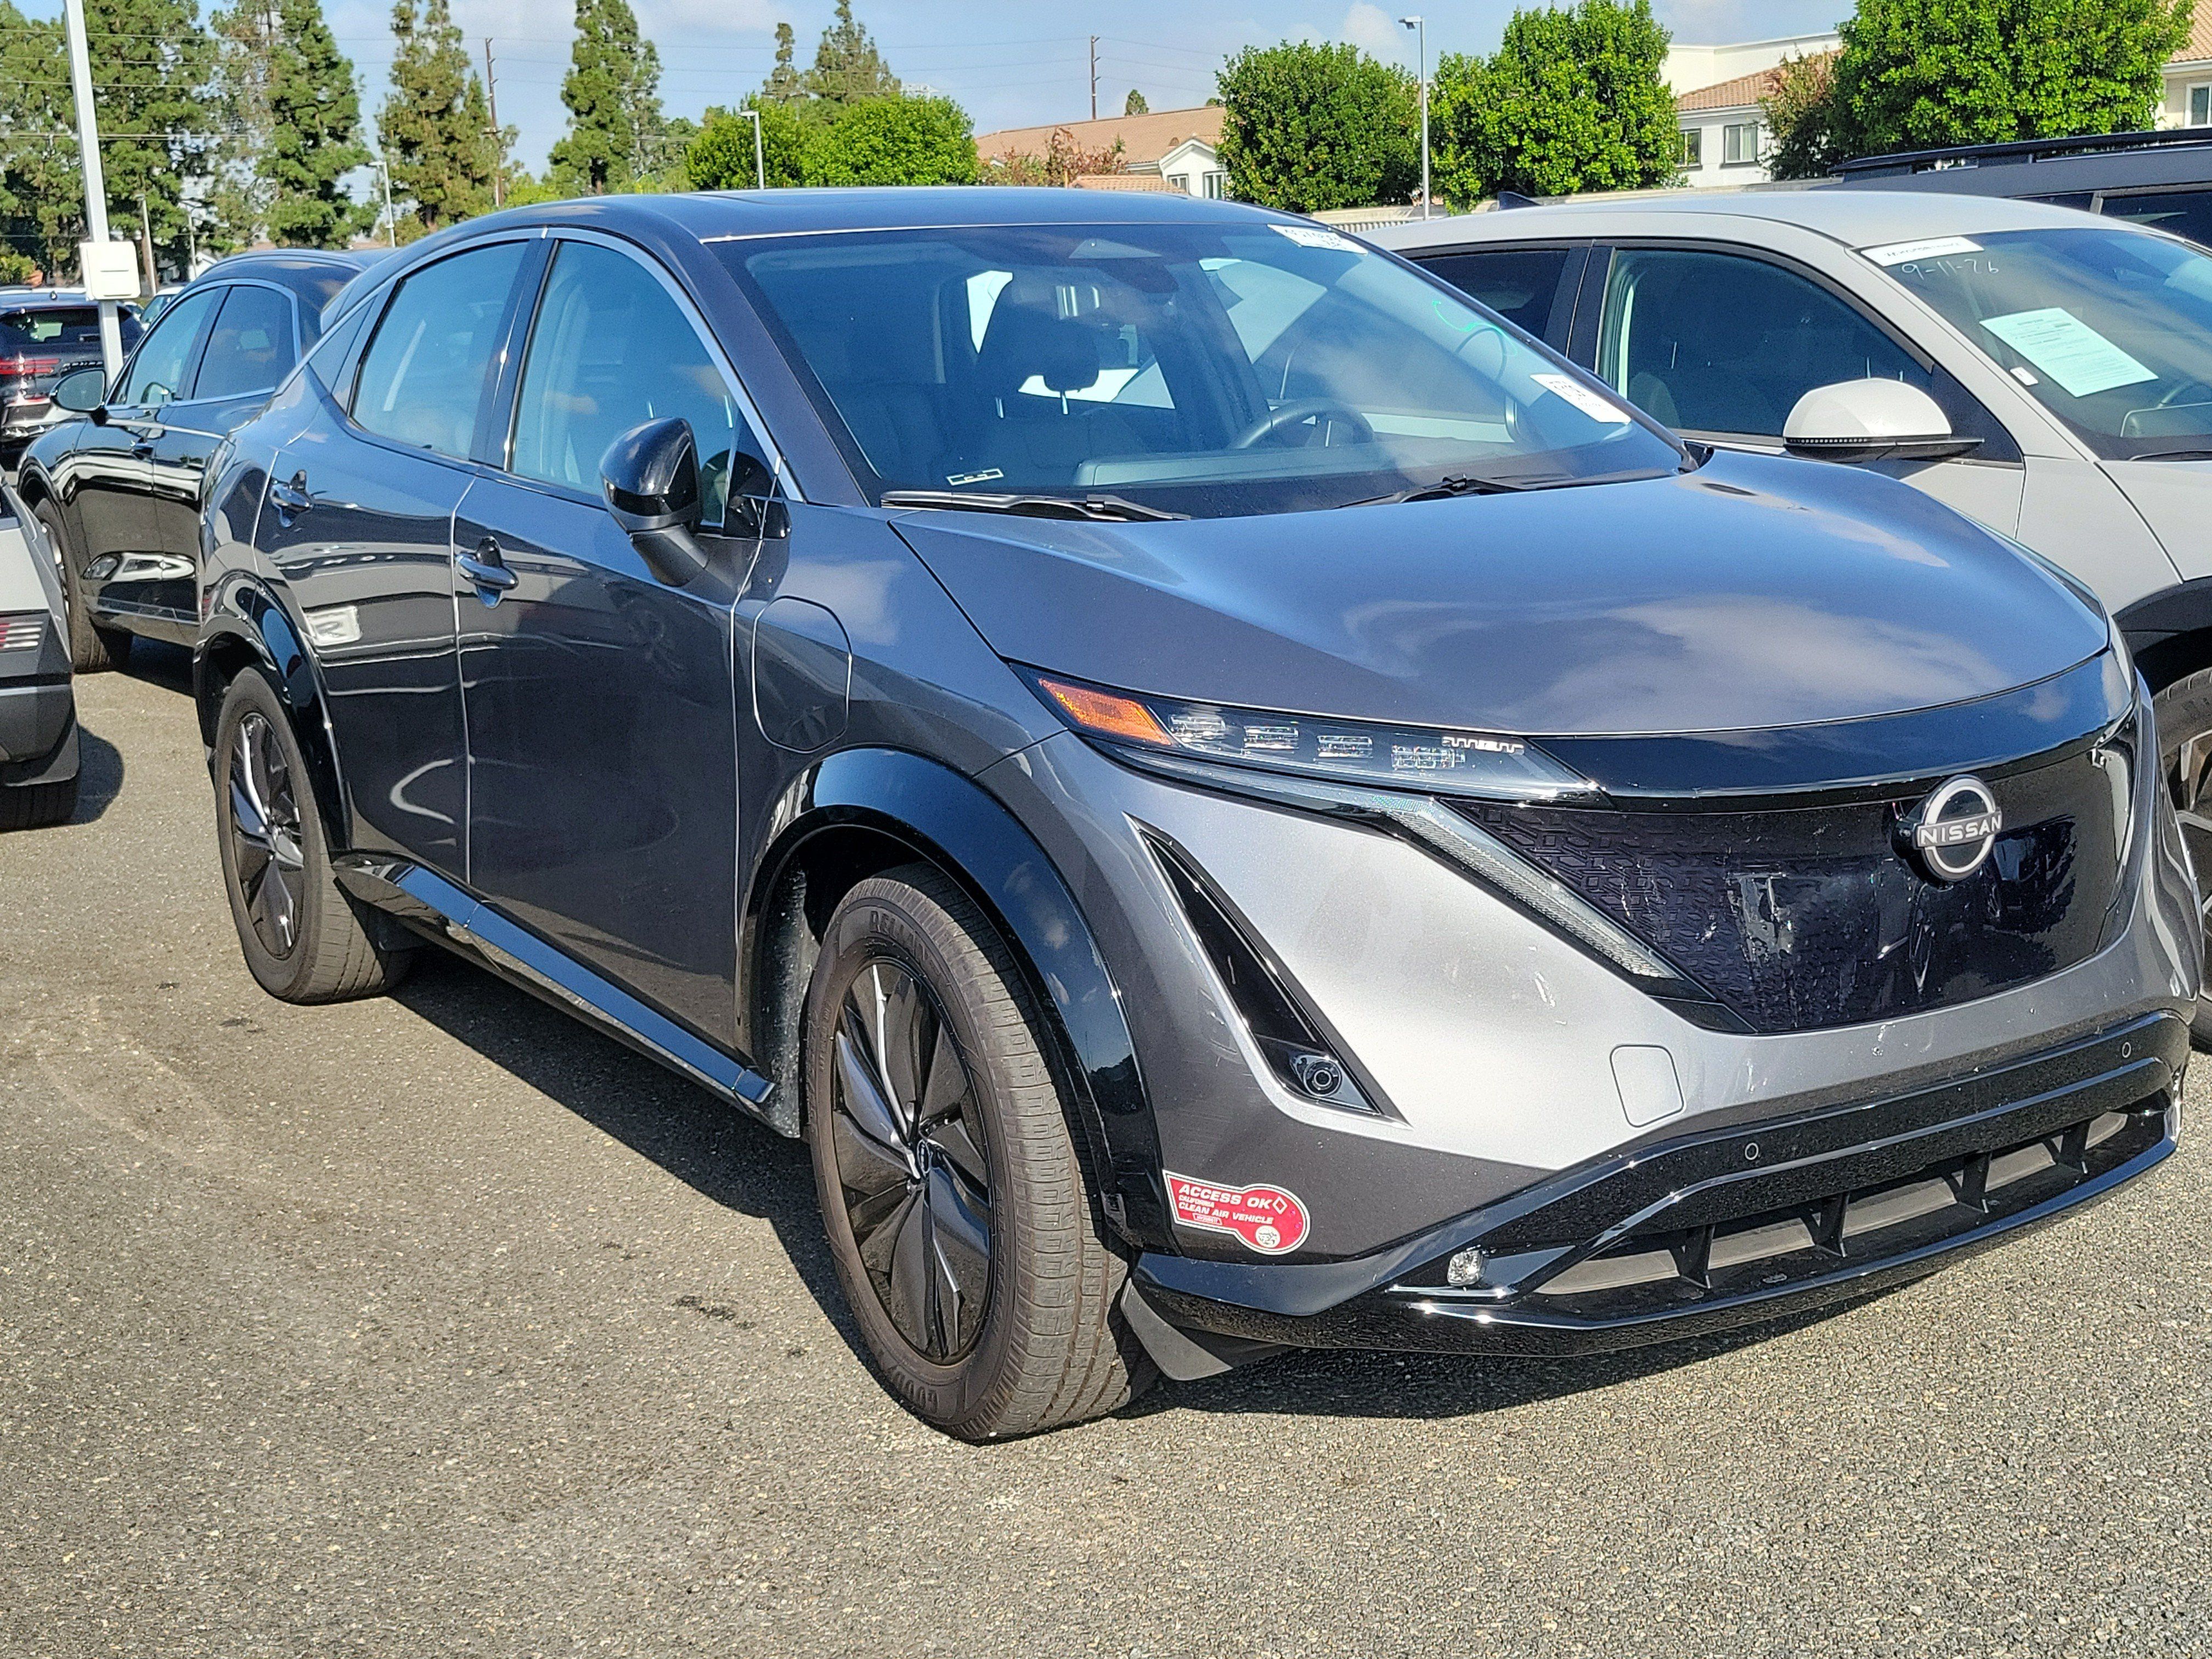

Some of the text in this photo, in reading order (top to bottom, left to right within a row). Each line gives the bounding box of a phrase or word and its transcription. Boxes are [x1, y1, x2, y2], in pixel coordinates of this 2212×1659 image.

[1920, 814, 2001, 844] NISSAN
[1178, 1184, 1273, 1210] ACCESS OK
[1178, 1201, 1210, 1215] CLEAN
[1211, 1209, 1230, 1219] AIR
[1232, 1212, 1274, 1224] VEHICLE
